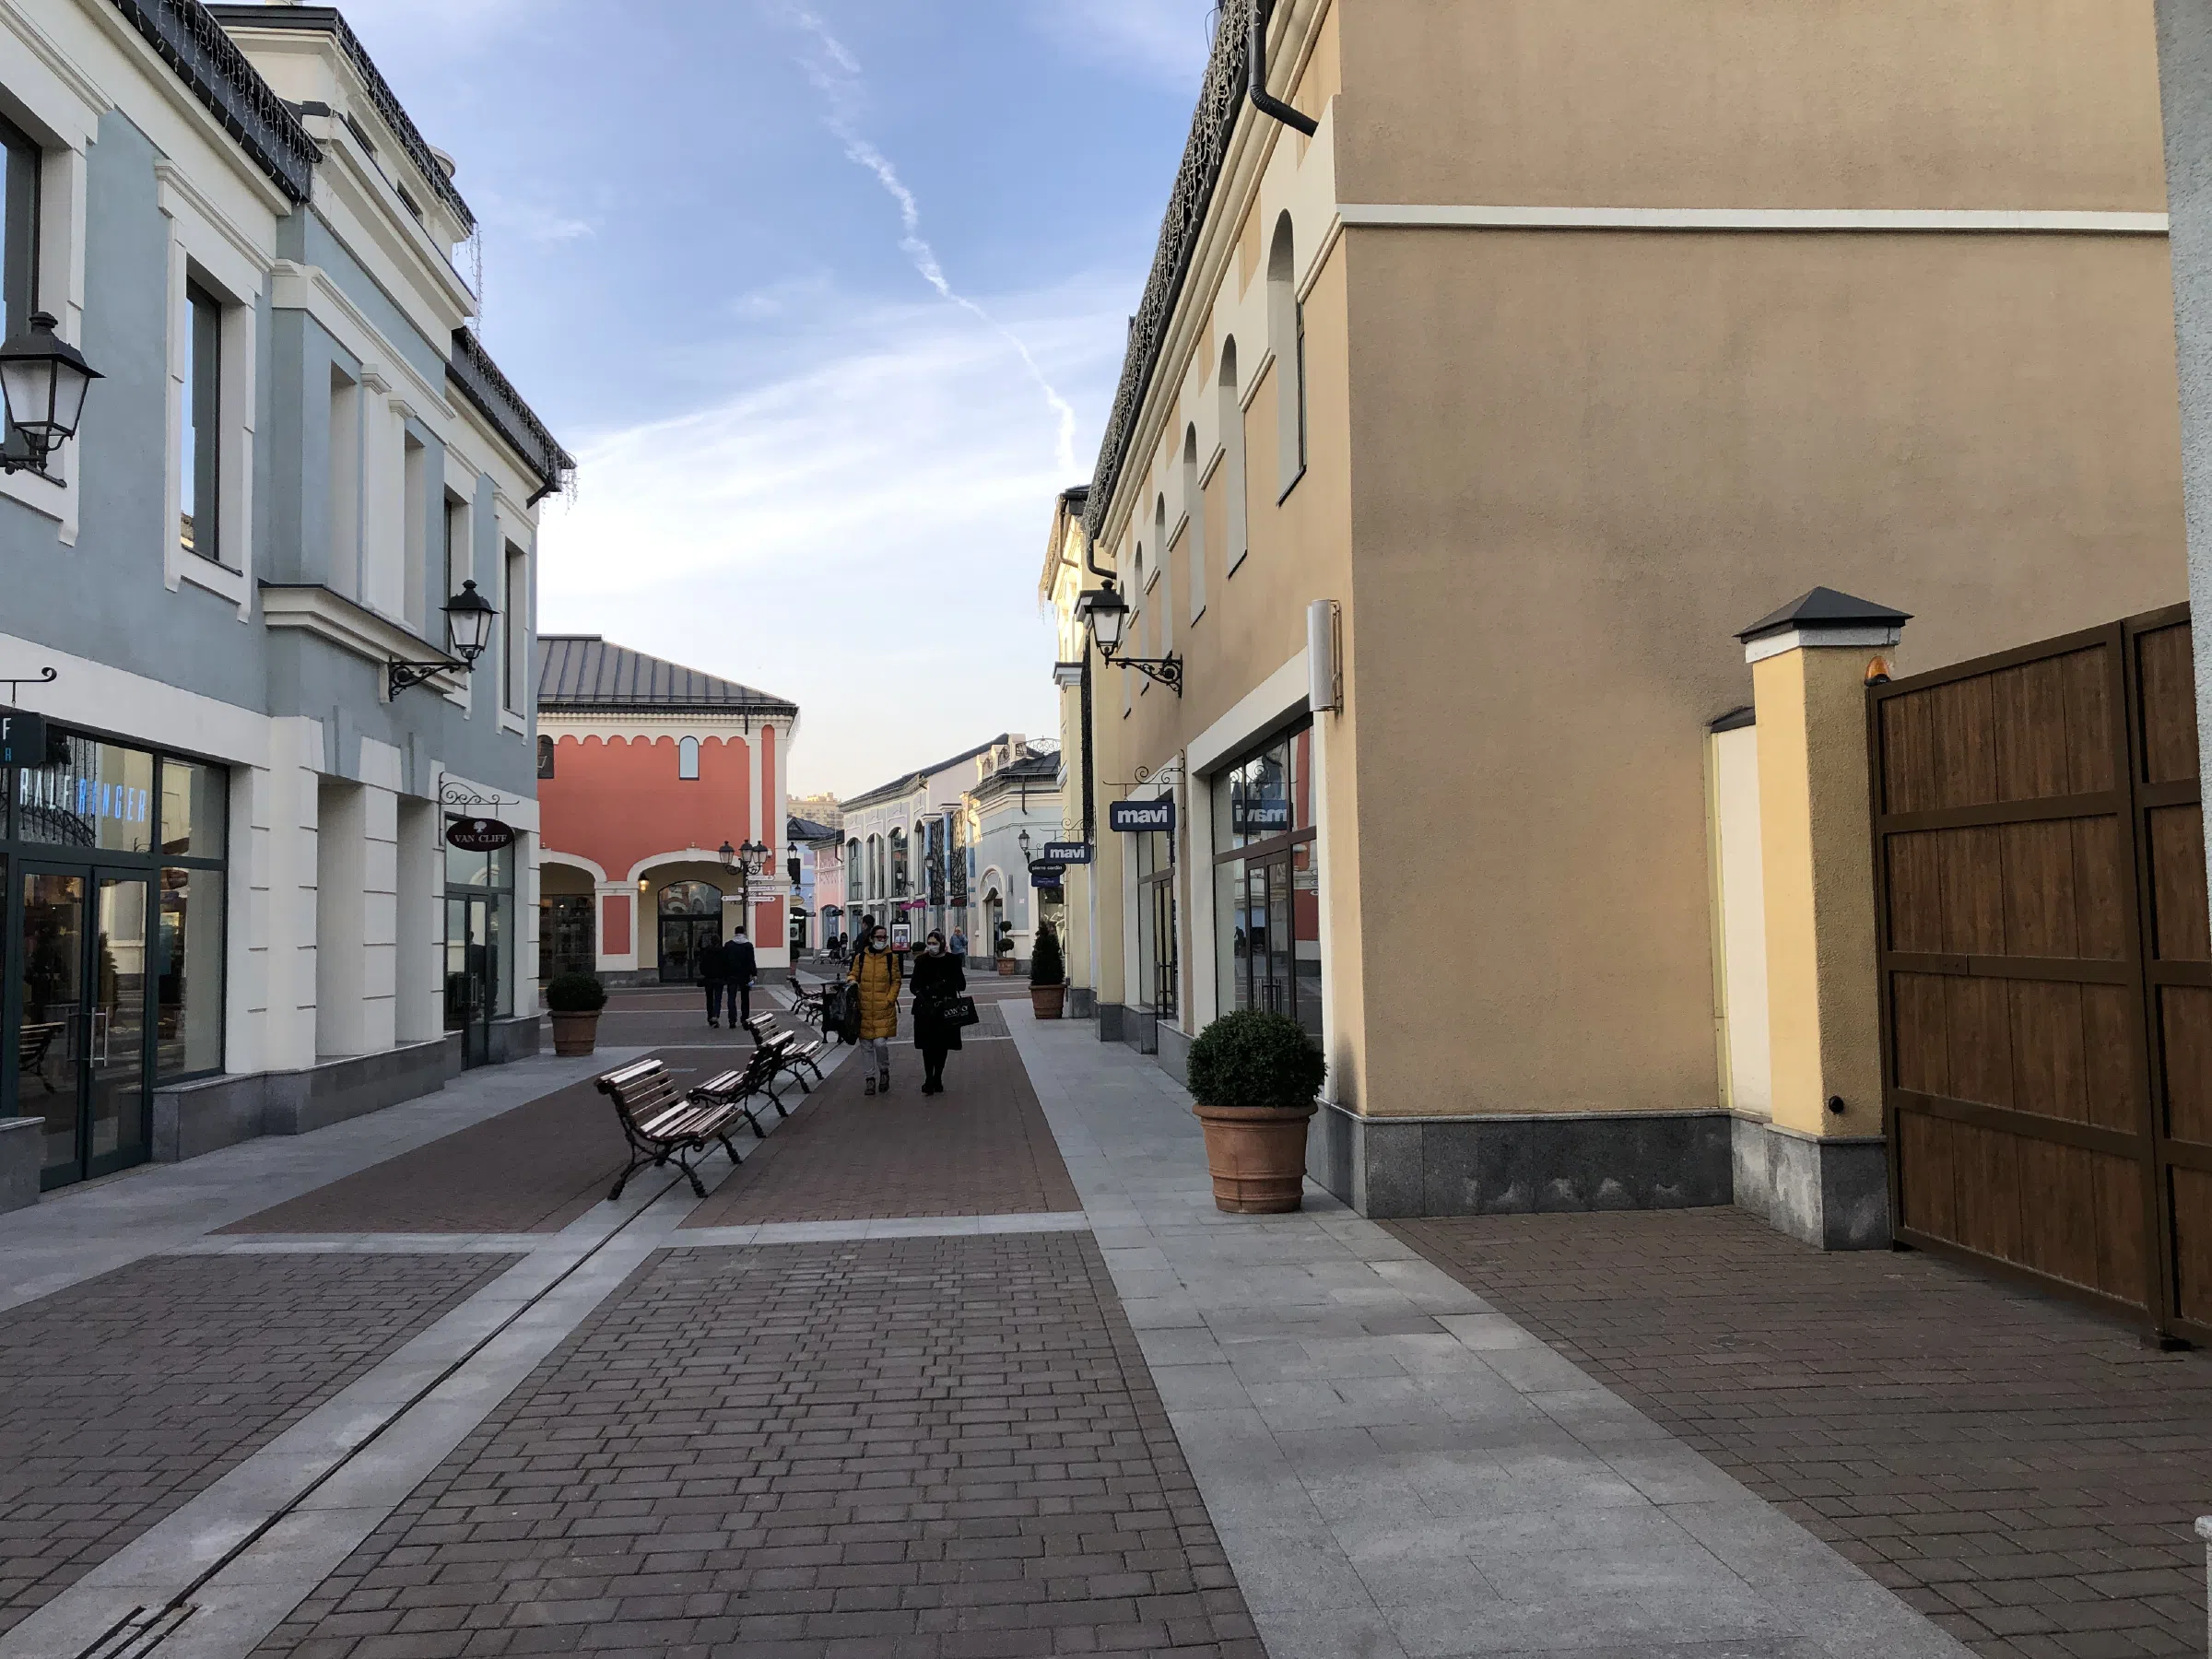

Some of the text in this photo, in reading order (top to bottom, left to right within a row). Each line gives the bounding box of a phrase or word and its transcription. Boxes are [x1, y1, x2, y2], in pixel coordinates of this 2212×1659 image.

[19, 767, 147, 822] RALF RINGER
[1117, 805, 1168, 823] mavi
[454, 834, 508, 842] VAN CLIFF
[1050, 846, 1085, 858] mavi
